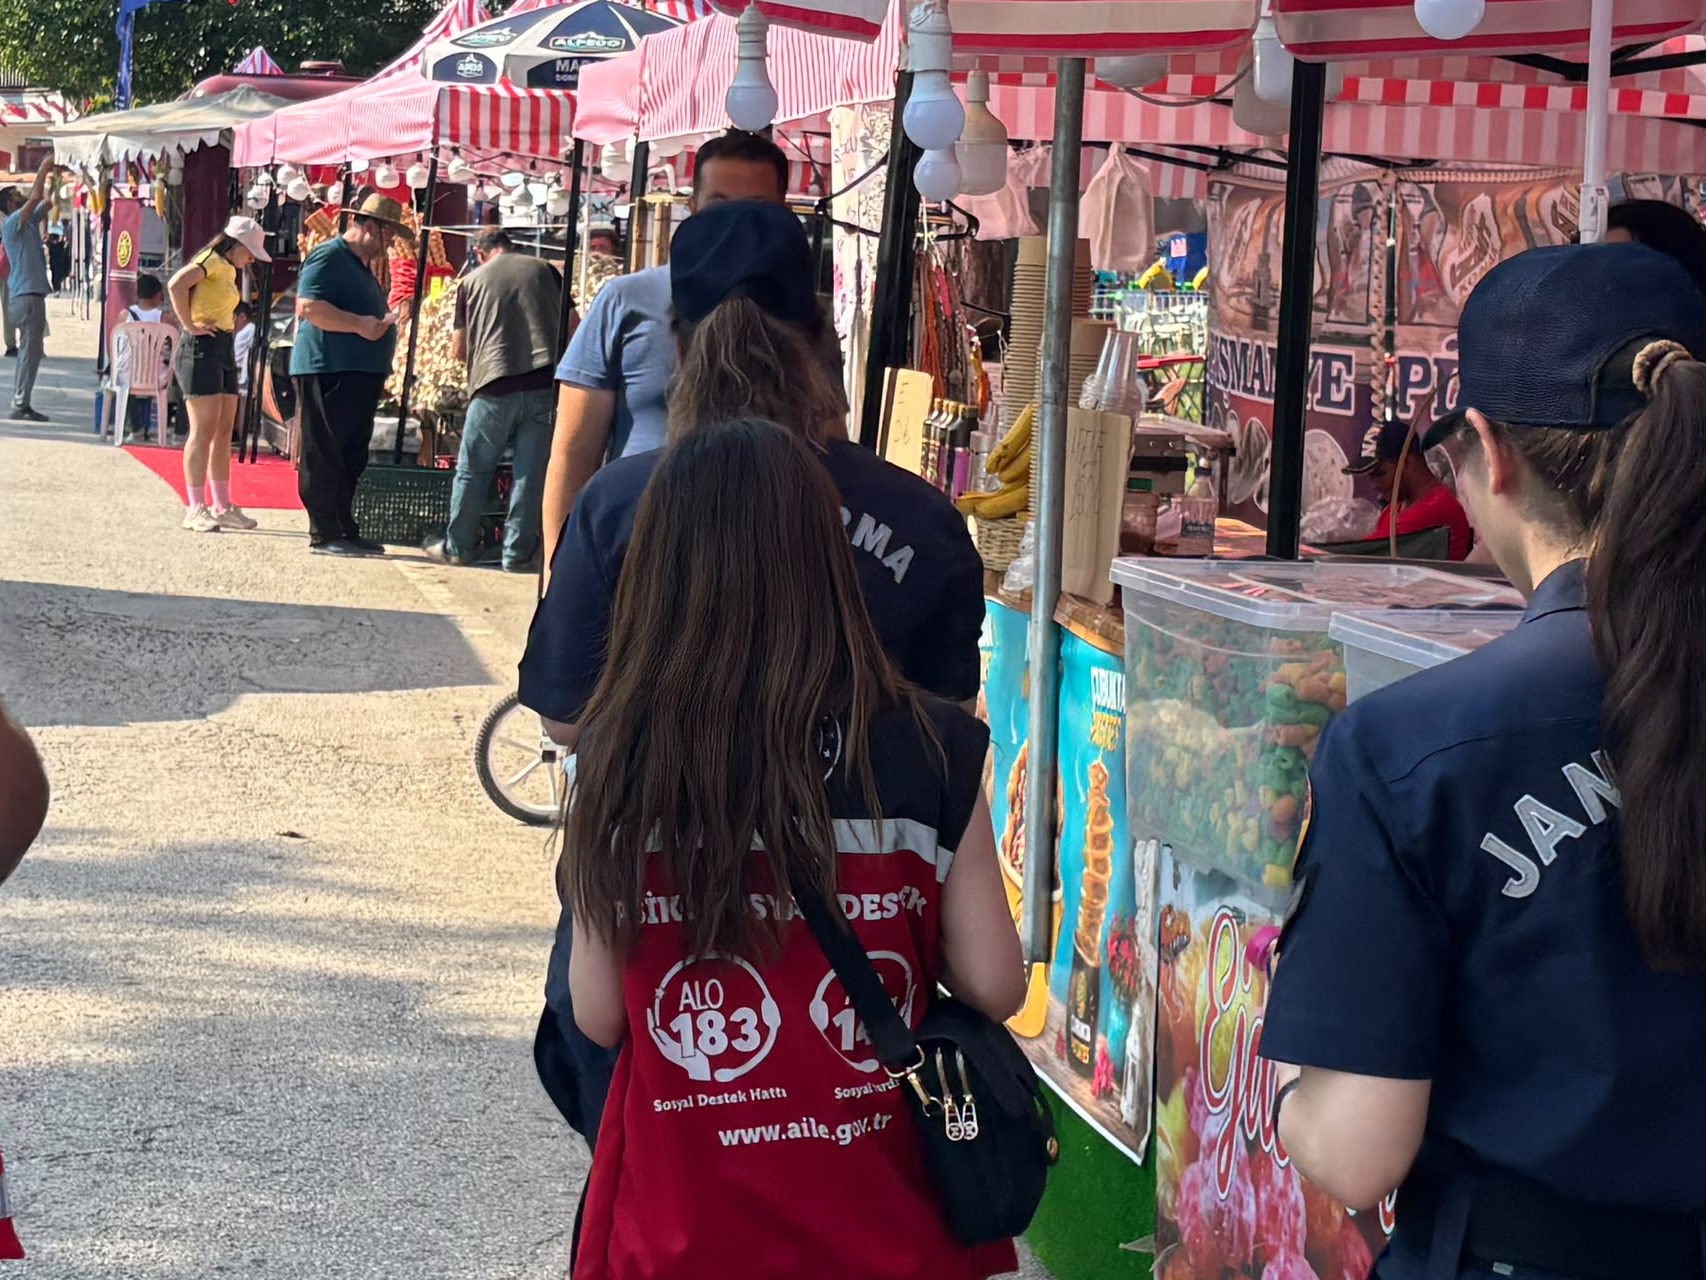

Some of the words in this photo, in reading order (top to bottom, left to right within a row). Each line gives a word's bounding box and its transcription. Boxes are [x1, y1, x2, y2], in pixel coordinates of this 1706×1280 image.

[679, 978, 724, 1012] ALO
[669, 1006, 761, 1058] 183
[653, 1095, 694, 1113] Sosyal
[697, 1091, 747, 1108] Destek
[750, 1086, 787, 1101] Hattı
[718, 1112, 892, 1147] www.aile.gov.tr
